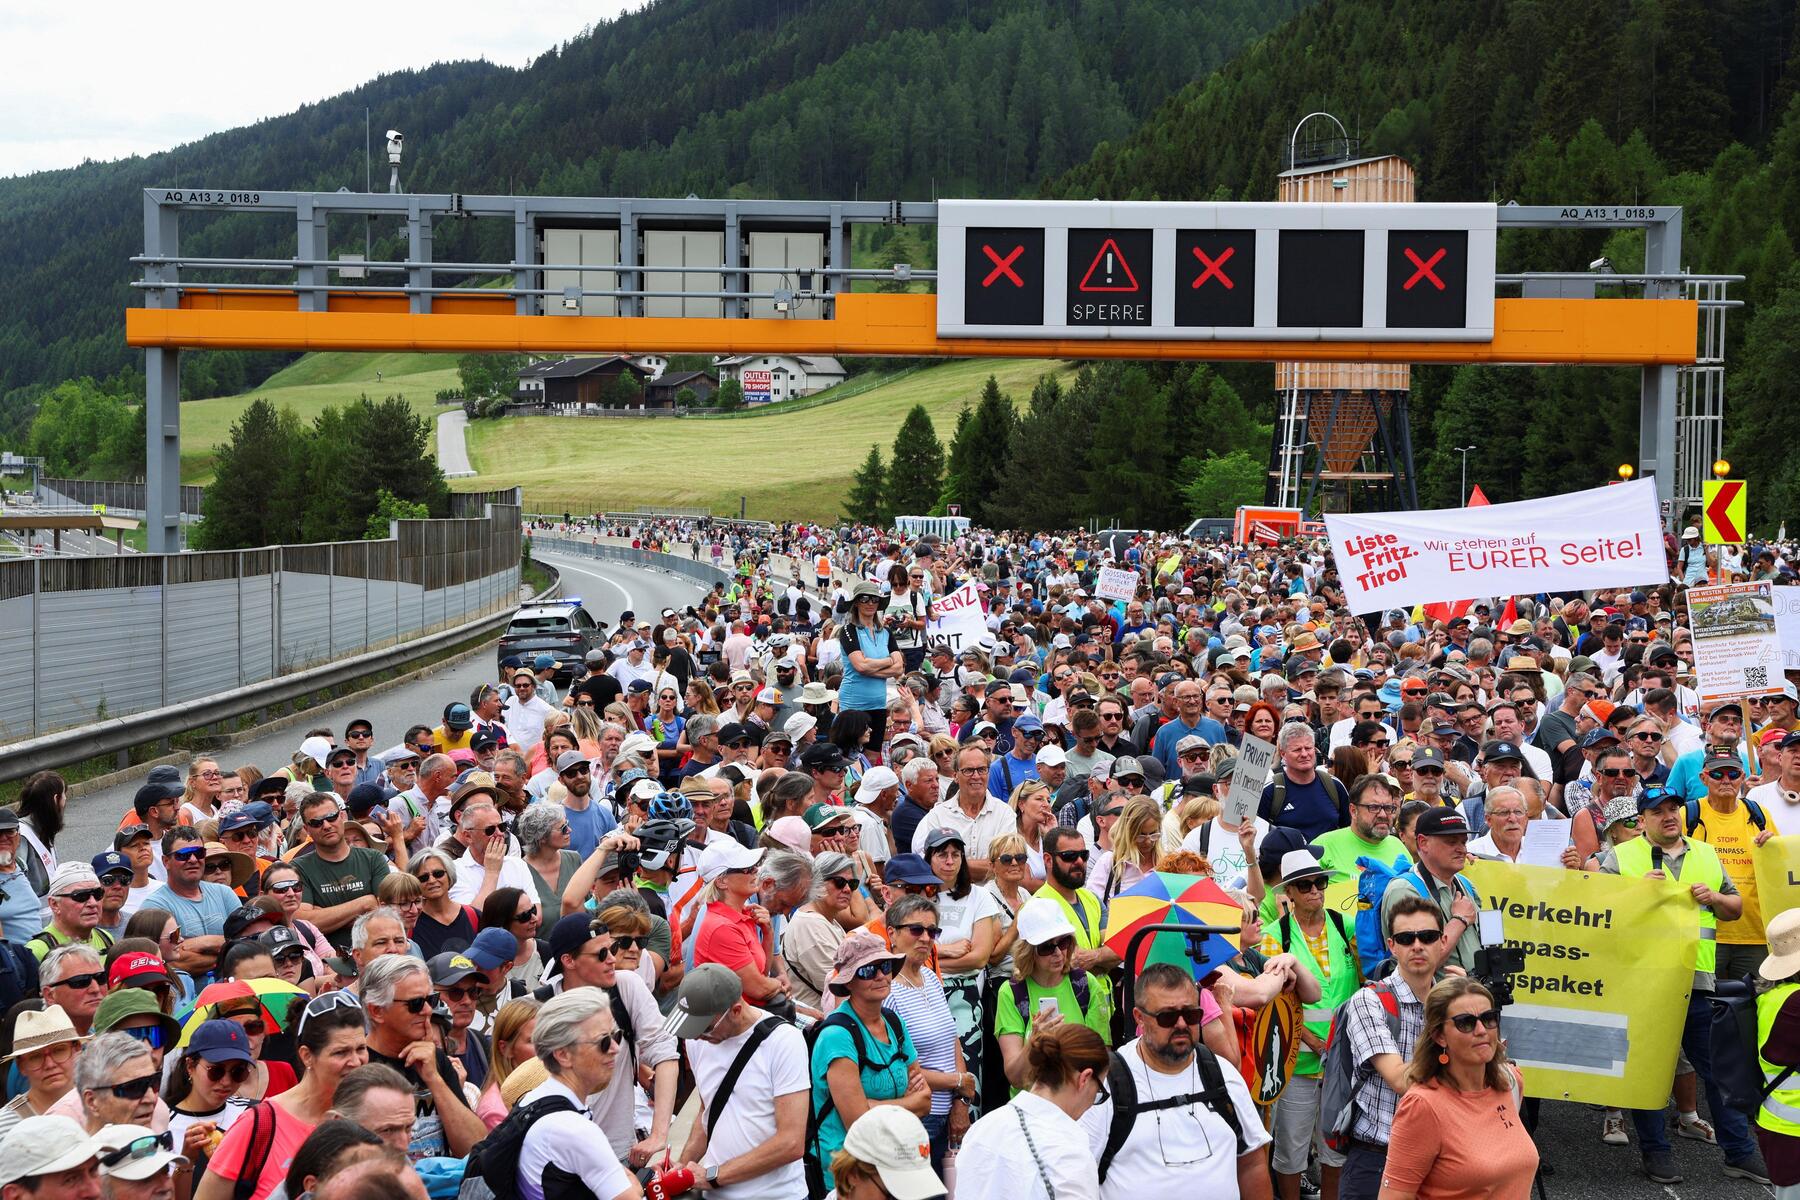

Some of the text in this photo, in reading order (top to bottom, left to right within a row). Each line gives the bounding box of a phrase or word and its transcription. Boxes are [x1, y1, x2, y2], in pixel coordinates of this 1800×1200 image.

[164, 191, 261, 205] AQ_A13_2_018,9
[1560, 208, 1656, 221] AQ_A13_1_018,9
[1073, 304, 1145, 320] SPERRE
[745, 372, 769, 380] OUTLET
[1344, 532, 1399, 558] Liste
[1423, 532, 1536, 552] Wir stehen auf
[1362, 542, 1420, 571] Fritz.
[1449, 532, 1643, 573] EURER Seite!
[1356, 560, 1408, 592] Tirol
[1101, 583, 1134, 597] VERKEHR
[1689, 590, 1702, 598] DER
[1701, 587, 1722, 597] WESTEN
[1723, 585, 1747, 595] BRAUCHT
[1738, 638, 1763, 647] tausende
[1701, 671, 1713, 679] Jetzt
[1243, 742, 1271, 769] PRIVAT
[1489, 895, 1613, 930] Verkehr!
[1503, 938, 1590, 962] npass-
